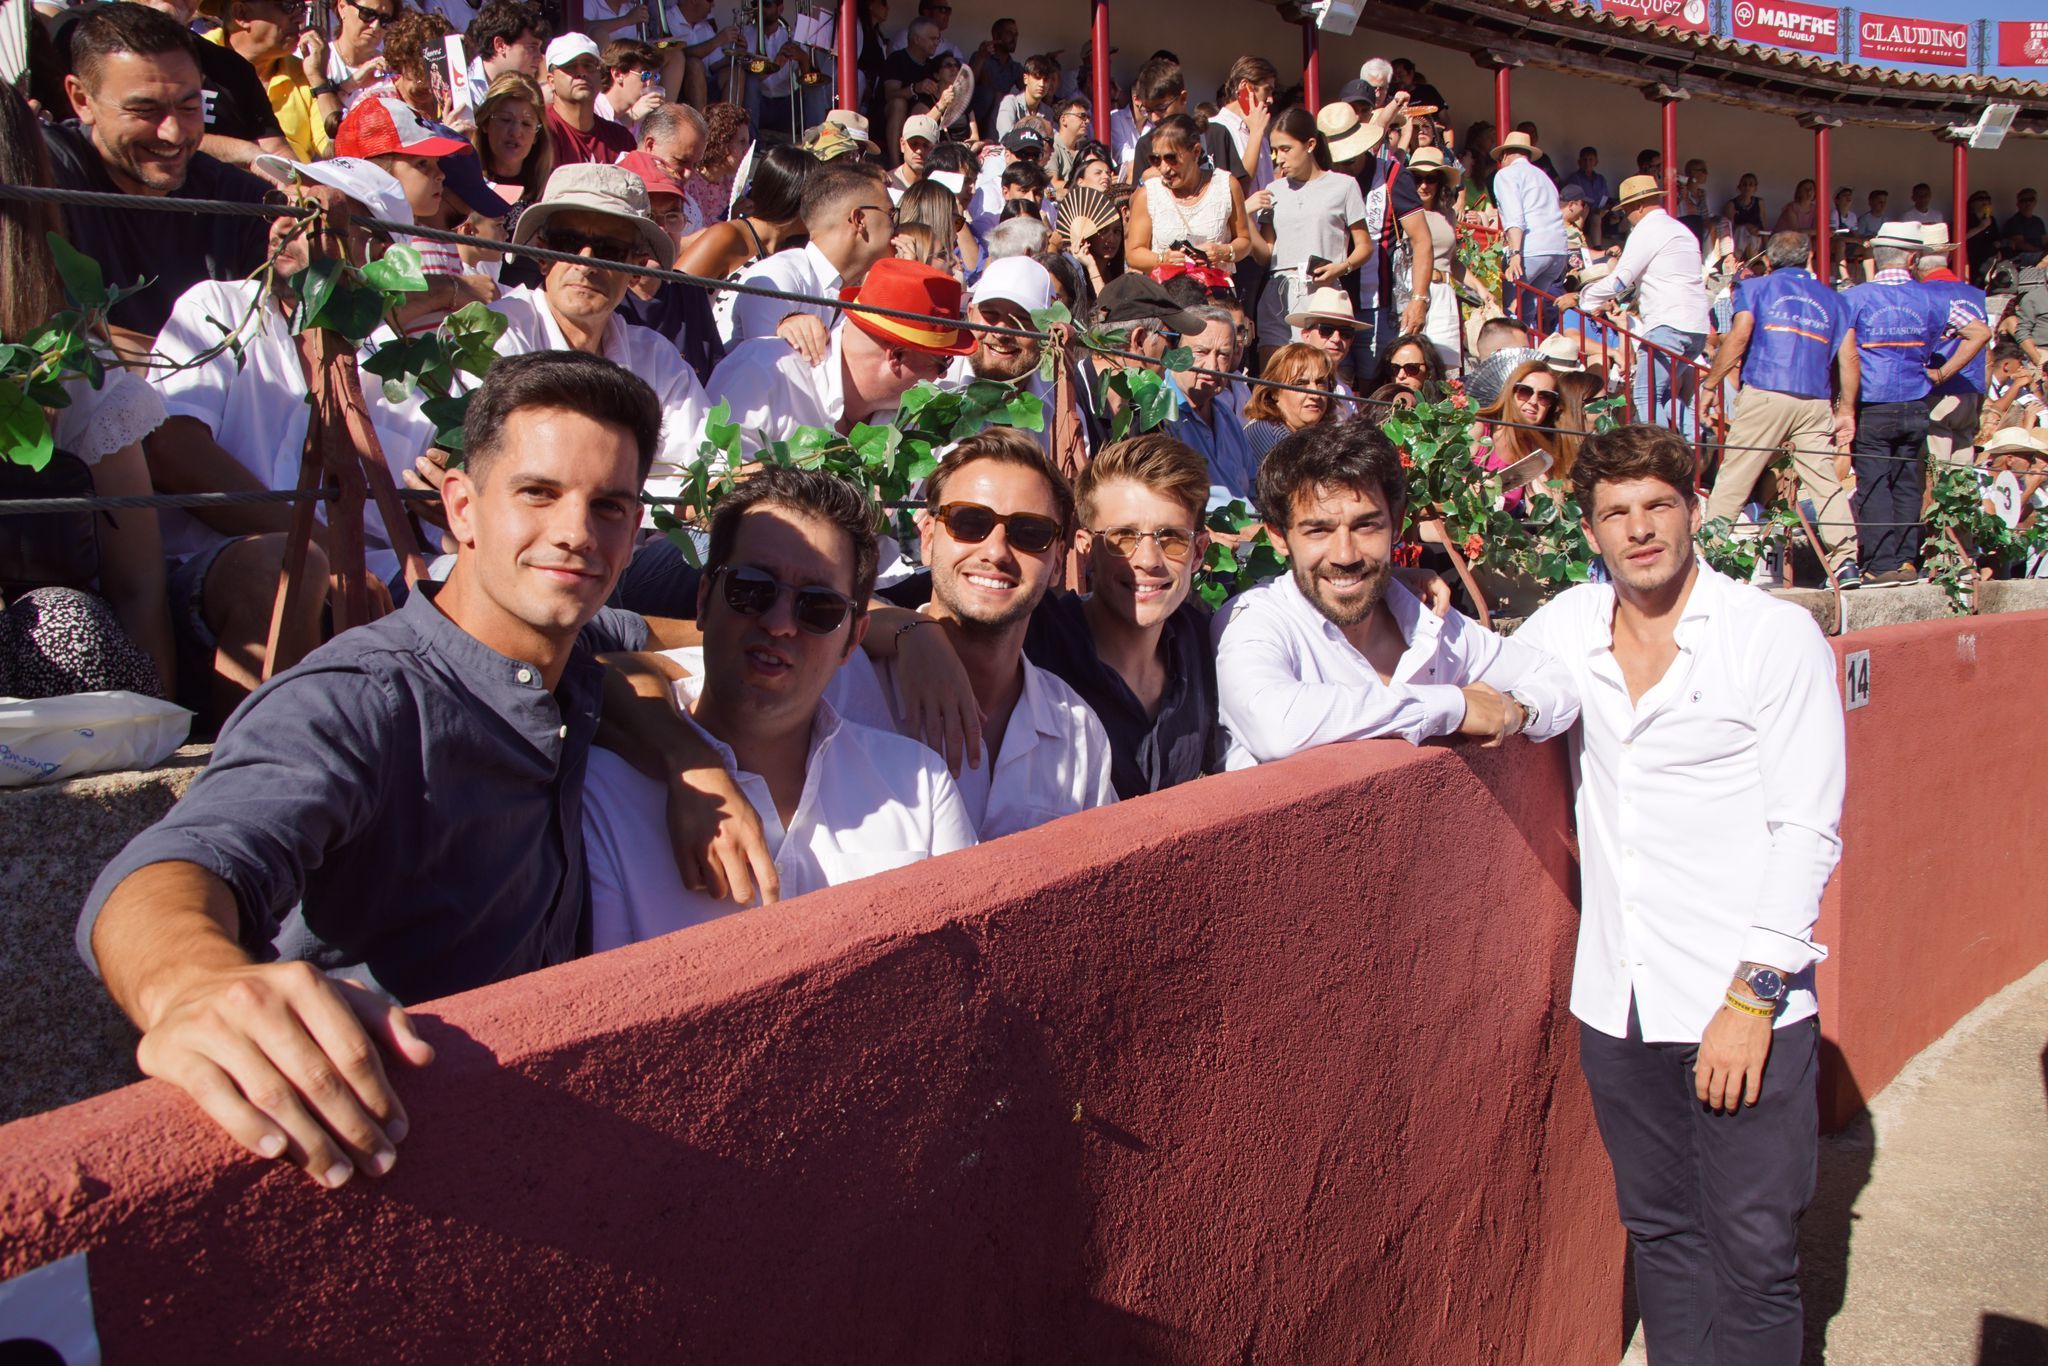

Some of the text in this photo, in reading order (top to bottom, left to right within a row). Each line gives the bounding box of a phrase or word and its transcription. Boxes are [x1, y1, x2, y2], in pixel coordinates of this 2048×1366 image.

[1757, 8, 1836, 36] MAPFRE
[1778, 29, 1815, 42] GUIJUELO
[1862, 22, 1967, 49] CLAUDINO
[1020, 131, 1038, 140] FILA
[1848, 658, 1868, 702] 14
